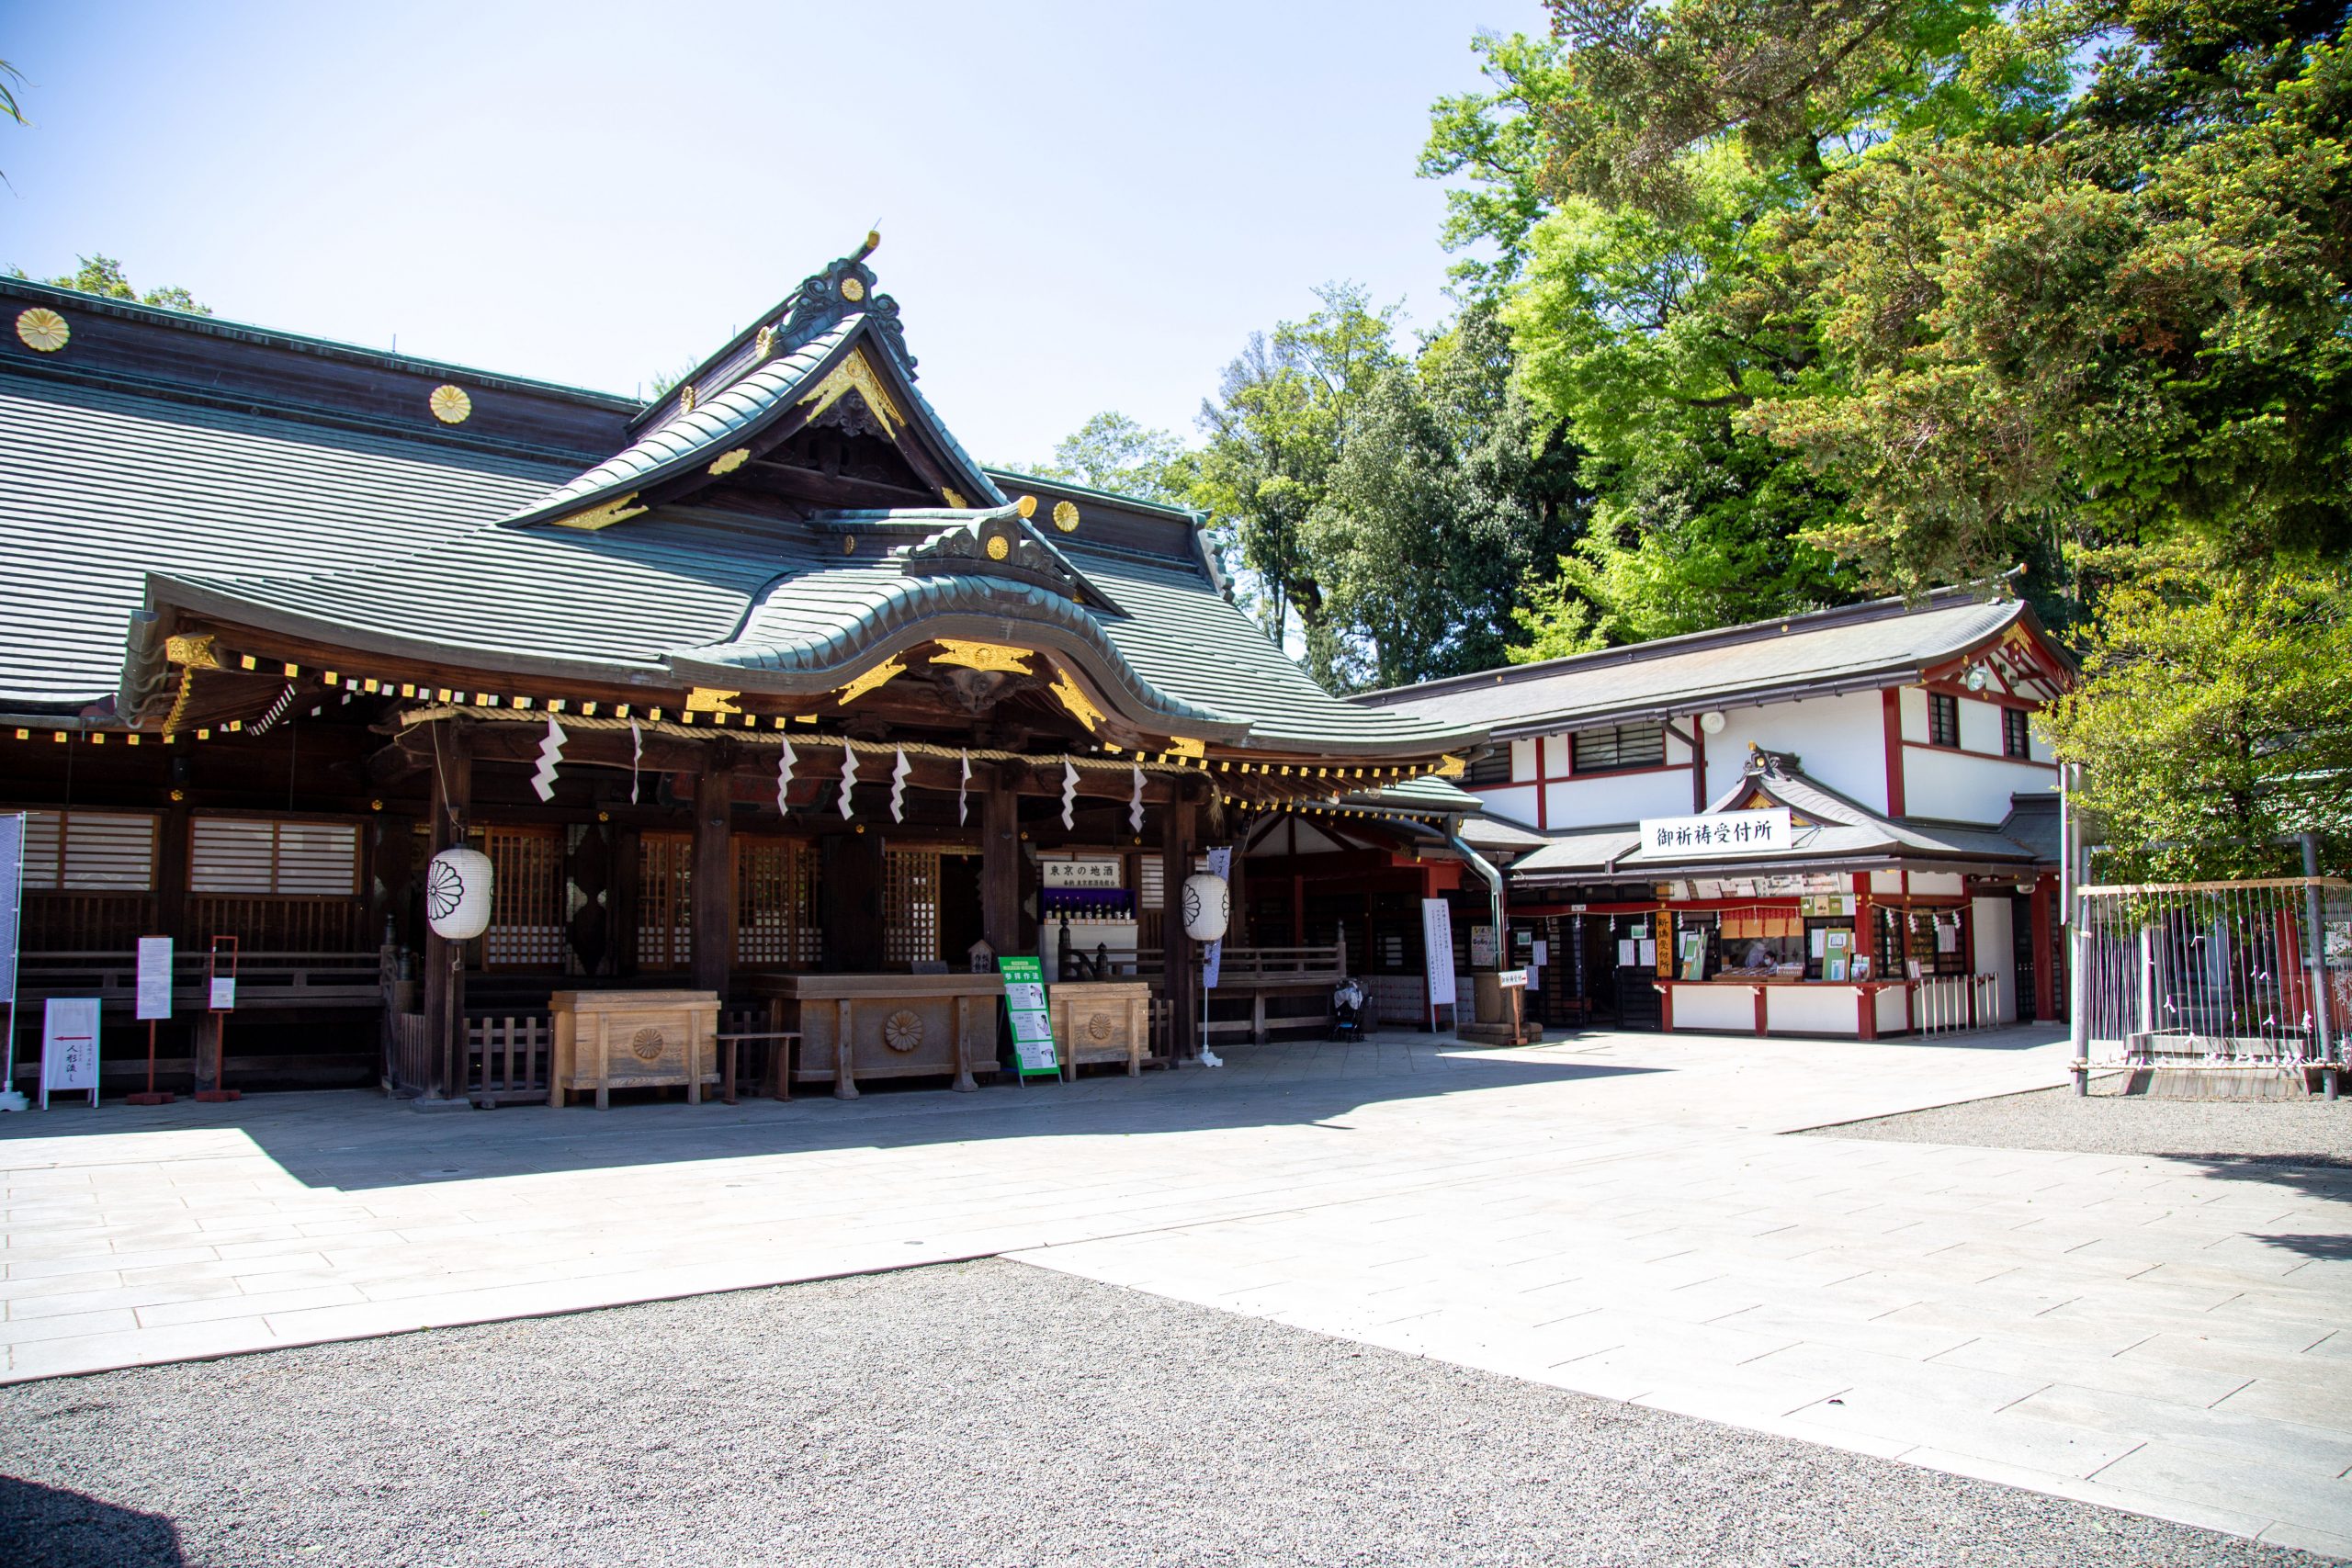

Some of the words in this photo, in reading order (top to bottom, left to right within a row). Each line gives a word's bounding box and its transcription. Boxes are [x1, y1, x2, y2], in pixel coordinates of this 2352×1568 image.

[1657, 819, 1771, 847] 御祈祷受付所
[1050, 865, 1114, 876] 東京の地酒
[66, 1044, 78, 1082] 人形流し
